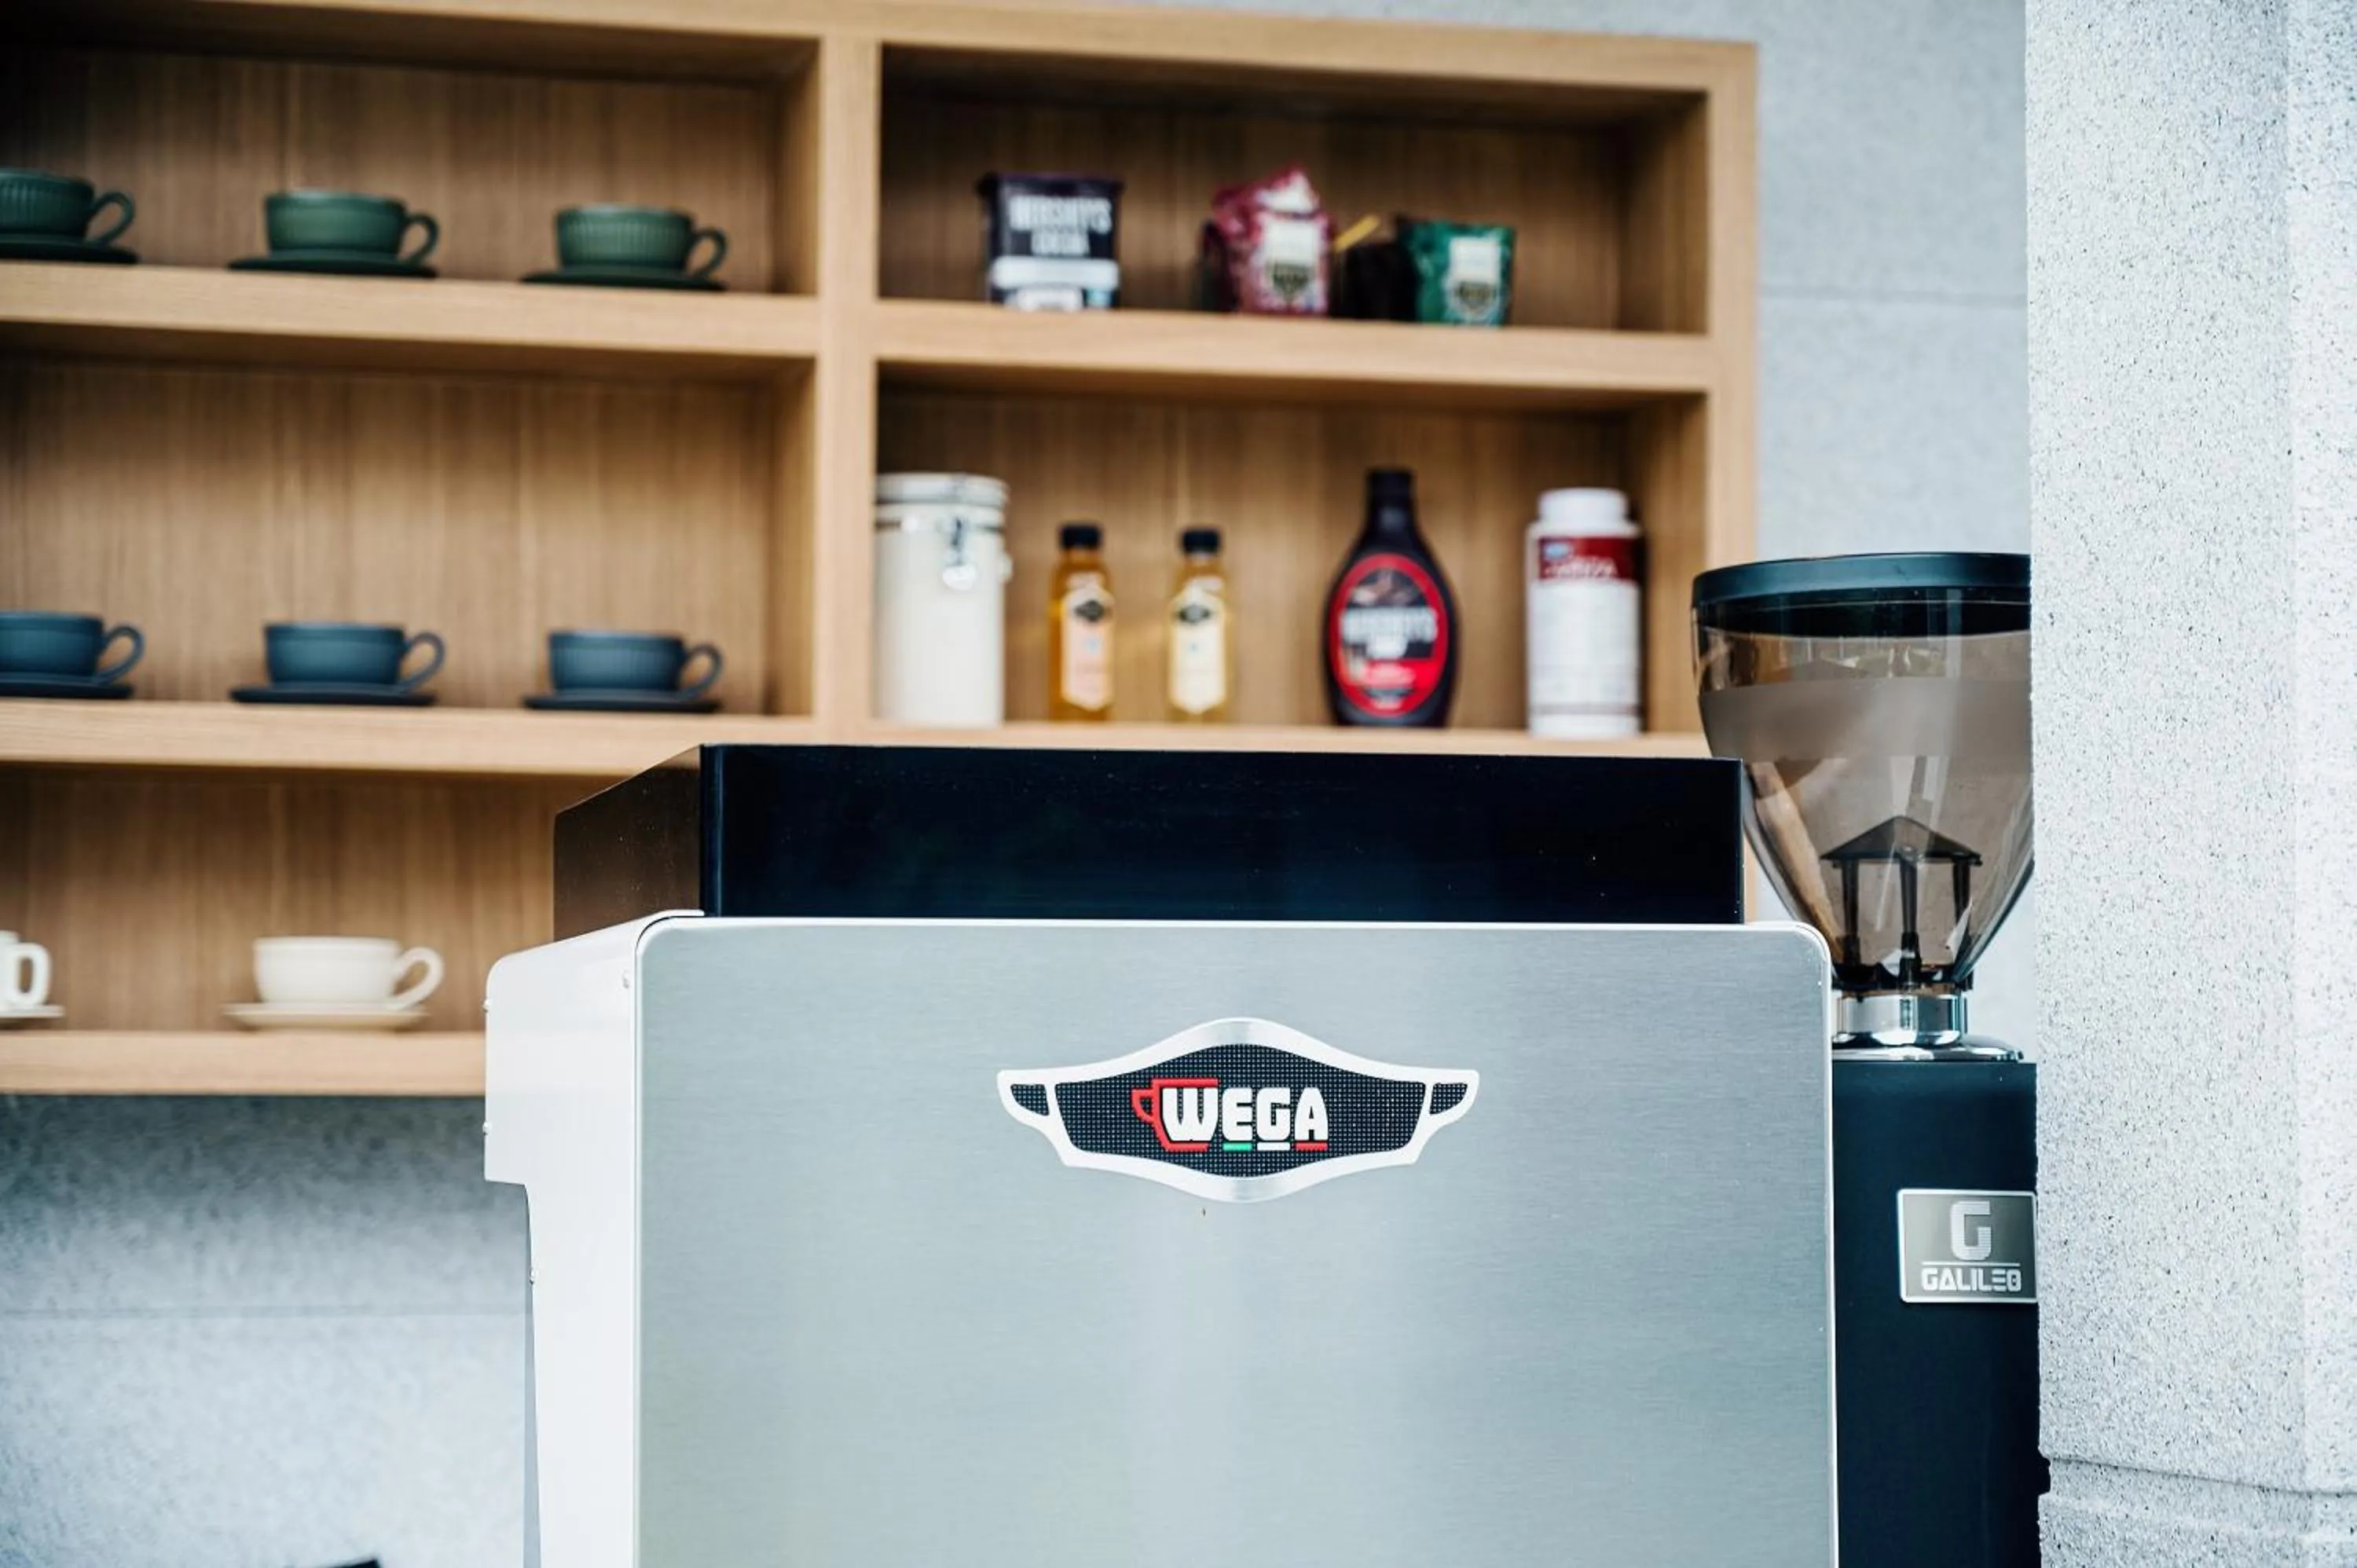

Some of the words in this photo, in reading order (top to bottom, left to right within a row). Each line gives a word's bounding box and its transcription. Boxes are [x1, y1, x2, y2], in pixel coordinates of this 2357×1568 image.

[1161, 1086, 1329, 1142] WEGA
[1950, 1200, 1992, 1261] G
[1921, 1267, 2022, 1291] GALILEO
